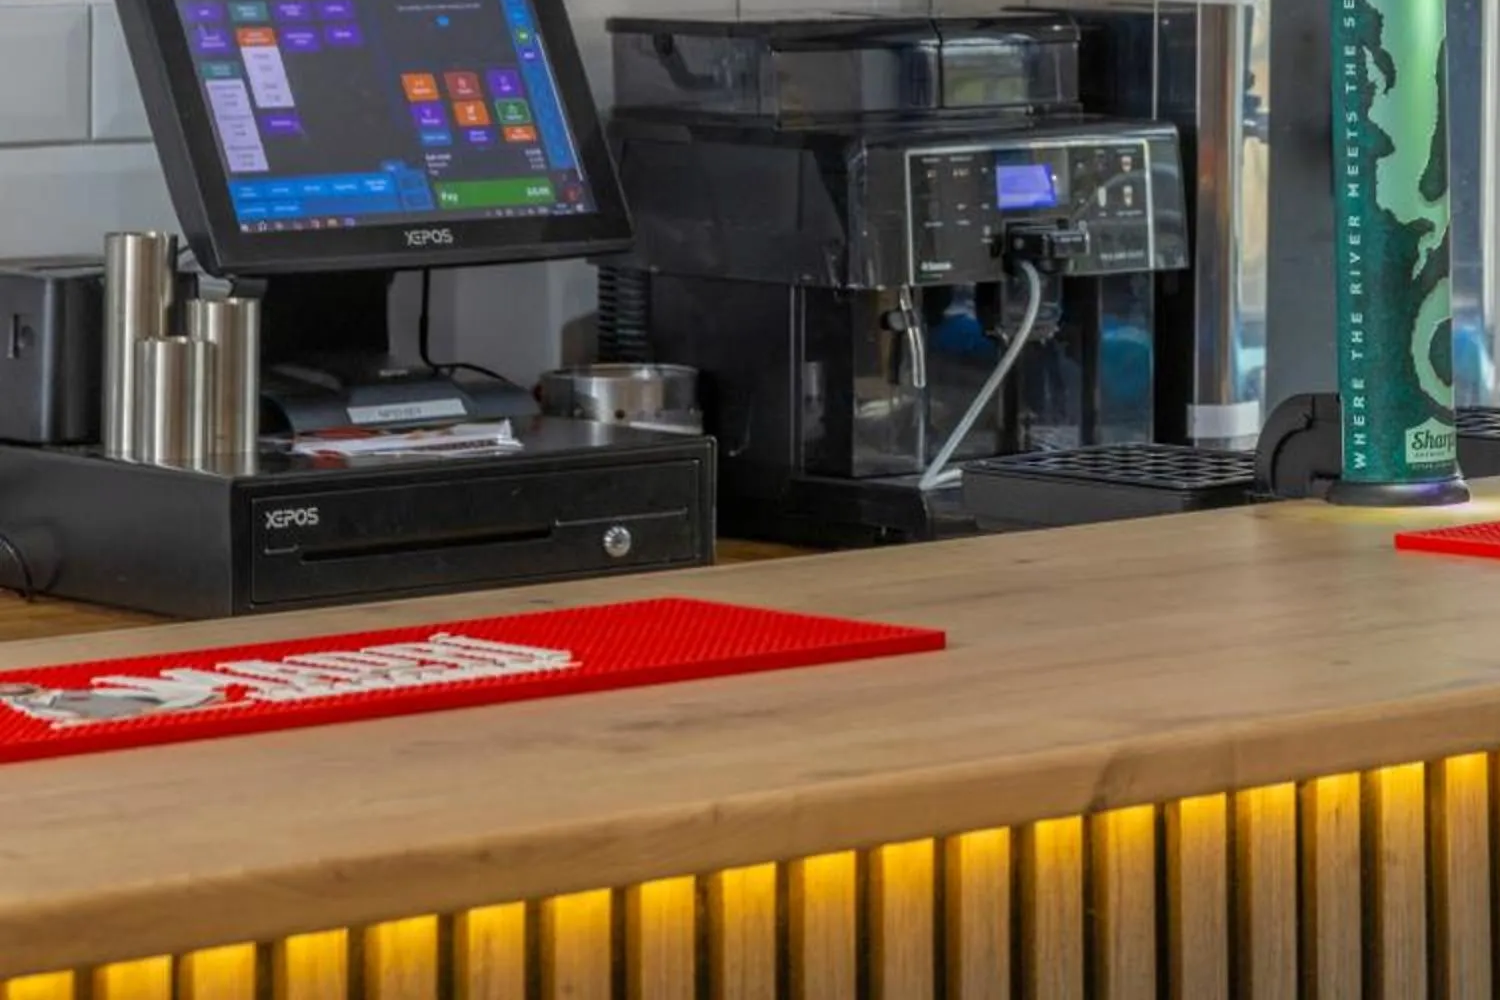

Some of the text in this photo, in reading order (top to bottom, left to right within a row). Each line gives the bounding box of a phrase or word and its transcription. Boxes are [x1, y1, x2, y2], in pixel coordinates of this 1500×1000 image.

[1344, 45, 1357, 94] THE
[1346, 112, 1359, 198] MEETS
[1348, 215, 1362, 295] RIVER
[1351, 312, 1363, 359] THE
[1353, 379, 1367, 469] WHERE
[264, 506, 320, 530] XEPOS
